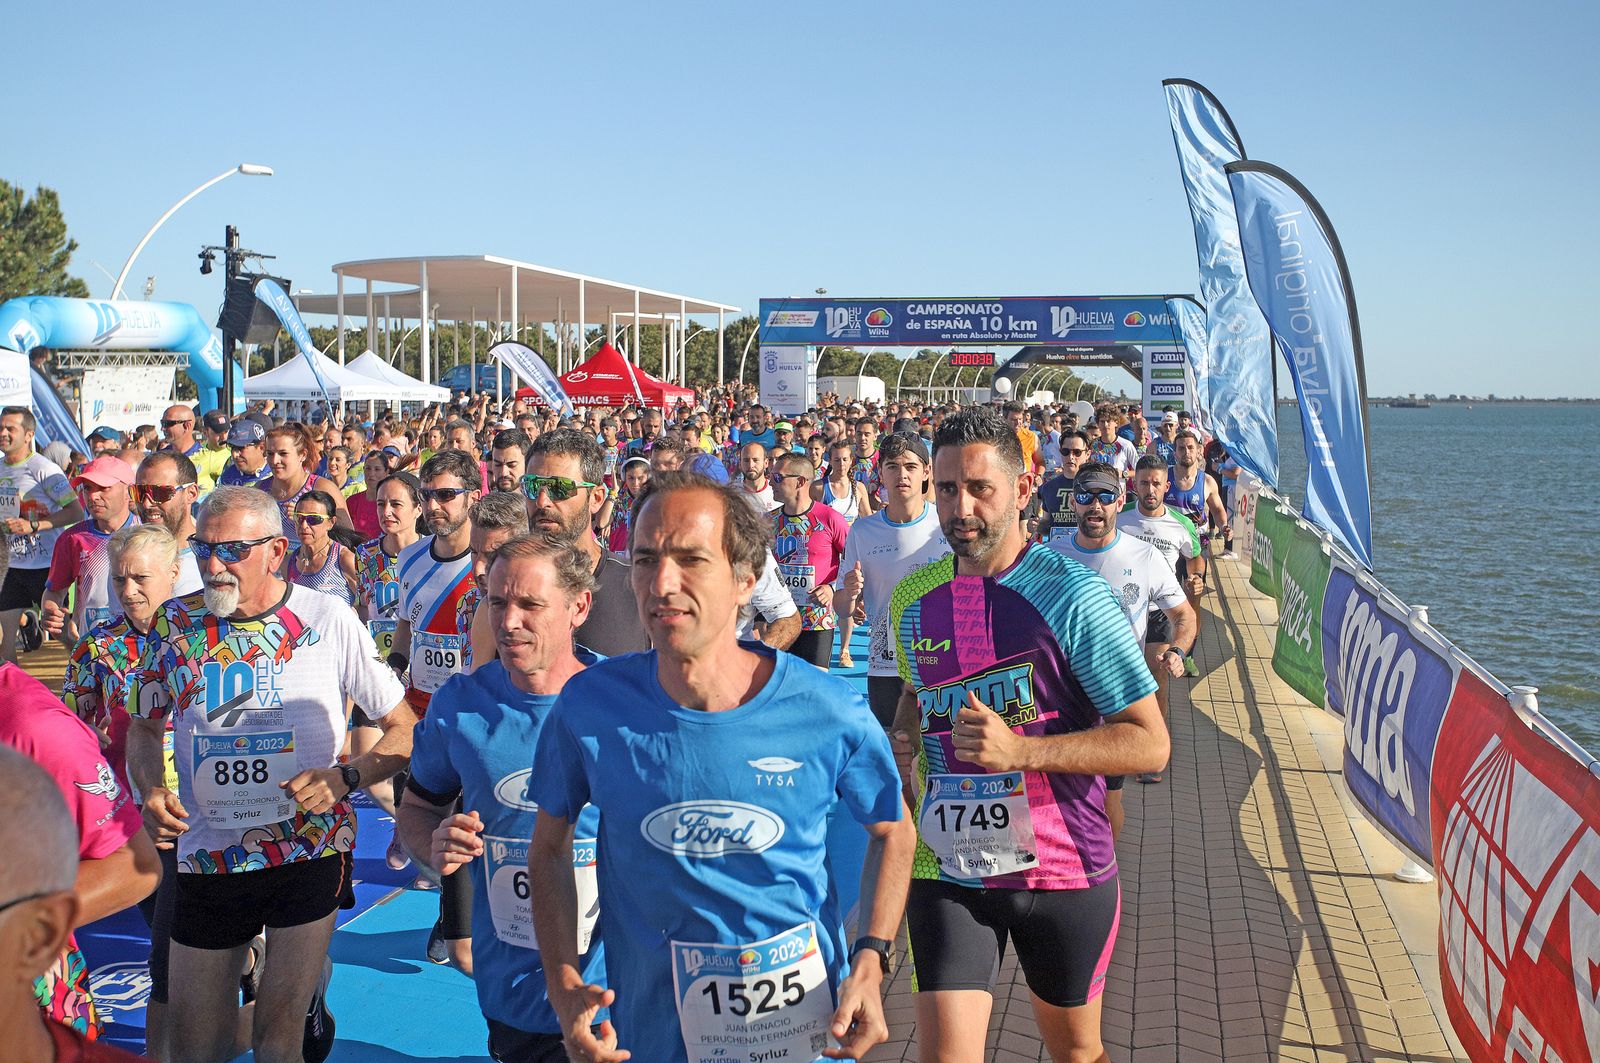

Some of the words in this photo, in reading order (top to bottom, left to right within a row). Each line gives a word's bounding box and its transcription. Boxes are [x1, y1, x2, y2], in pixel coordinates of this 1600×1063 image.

[906, 303, 1004, 315] CAMPEONATO
[906, 319, 921, 330] de
[924, 317, 973, 330] ESPAÑA
[981, 316, 1003, 331] 10
[1008, 315, 1038, 331] km
[1074, 312, 1115, 325] HUELVA
[1149, 313, 1178, 326] WiH
[868, 328, 890, 336] WiHu
[1051, 512, 1077, 520] TRINIT
[1152, 537, 1172, 547] FONDO
[424, 648, 456, 669] 809
[254, 711, 274, 719] PUERTA
[274, 711, 283, 719] DEL
[241, 718, 283, 726] DESCUBRIMIENTO
[209, 741, 231, 751] HUELVA
[256, 738, 285, 751] 2023
[214, 759, 269, 786] 888
[755, 774, 795, 787] TYSA
[247, 796, 280, 805] TORONJO
[233, 809, 262, 820] Syrluz
[934, 803, 1010, 832] 1749
[671, 809, 755, 845] Ford
[970, 836, 996, 845] DIEGO
[506, 848, 530, 859] HUELV
[954, 846, 978, 855] ANDIA
[978, 844, 1000, 852] SOTO
[968, 857, 998, 869] Syrluz
[703, 954, 735, 968] HUELVA
[768, 936, 807, 966] 2023
[702, 970, 806, 1017] 1525
[725, 1025, 749, 1034] JUAN
[750, 1017, 791, 1033] IGNACIO
[700, 1034, 759, 1045] PERUCHENA
[761, 1020, 818, 1044] FERNANDEZ
[749, 1047, 789, 1063] Syrluz
